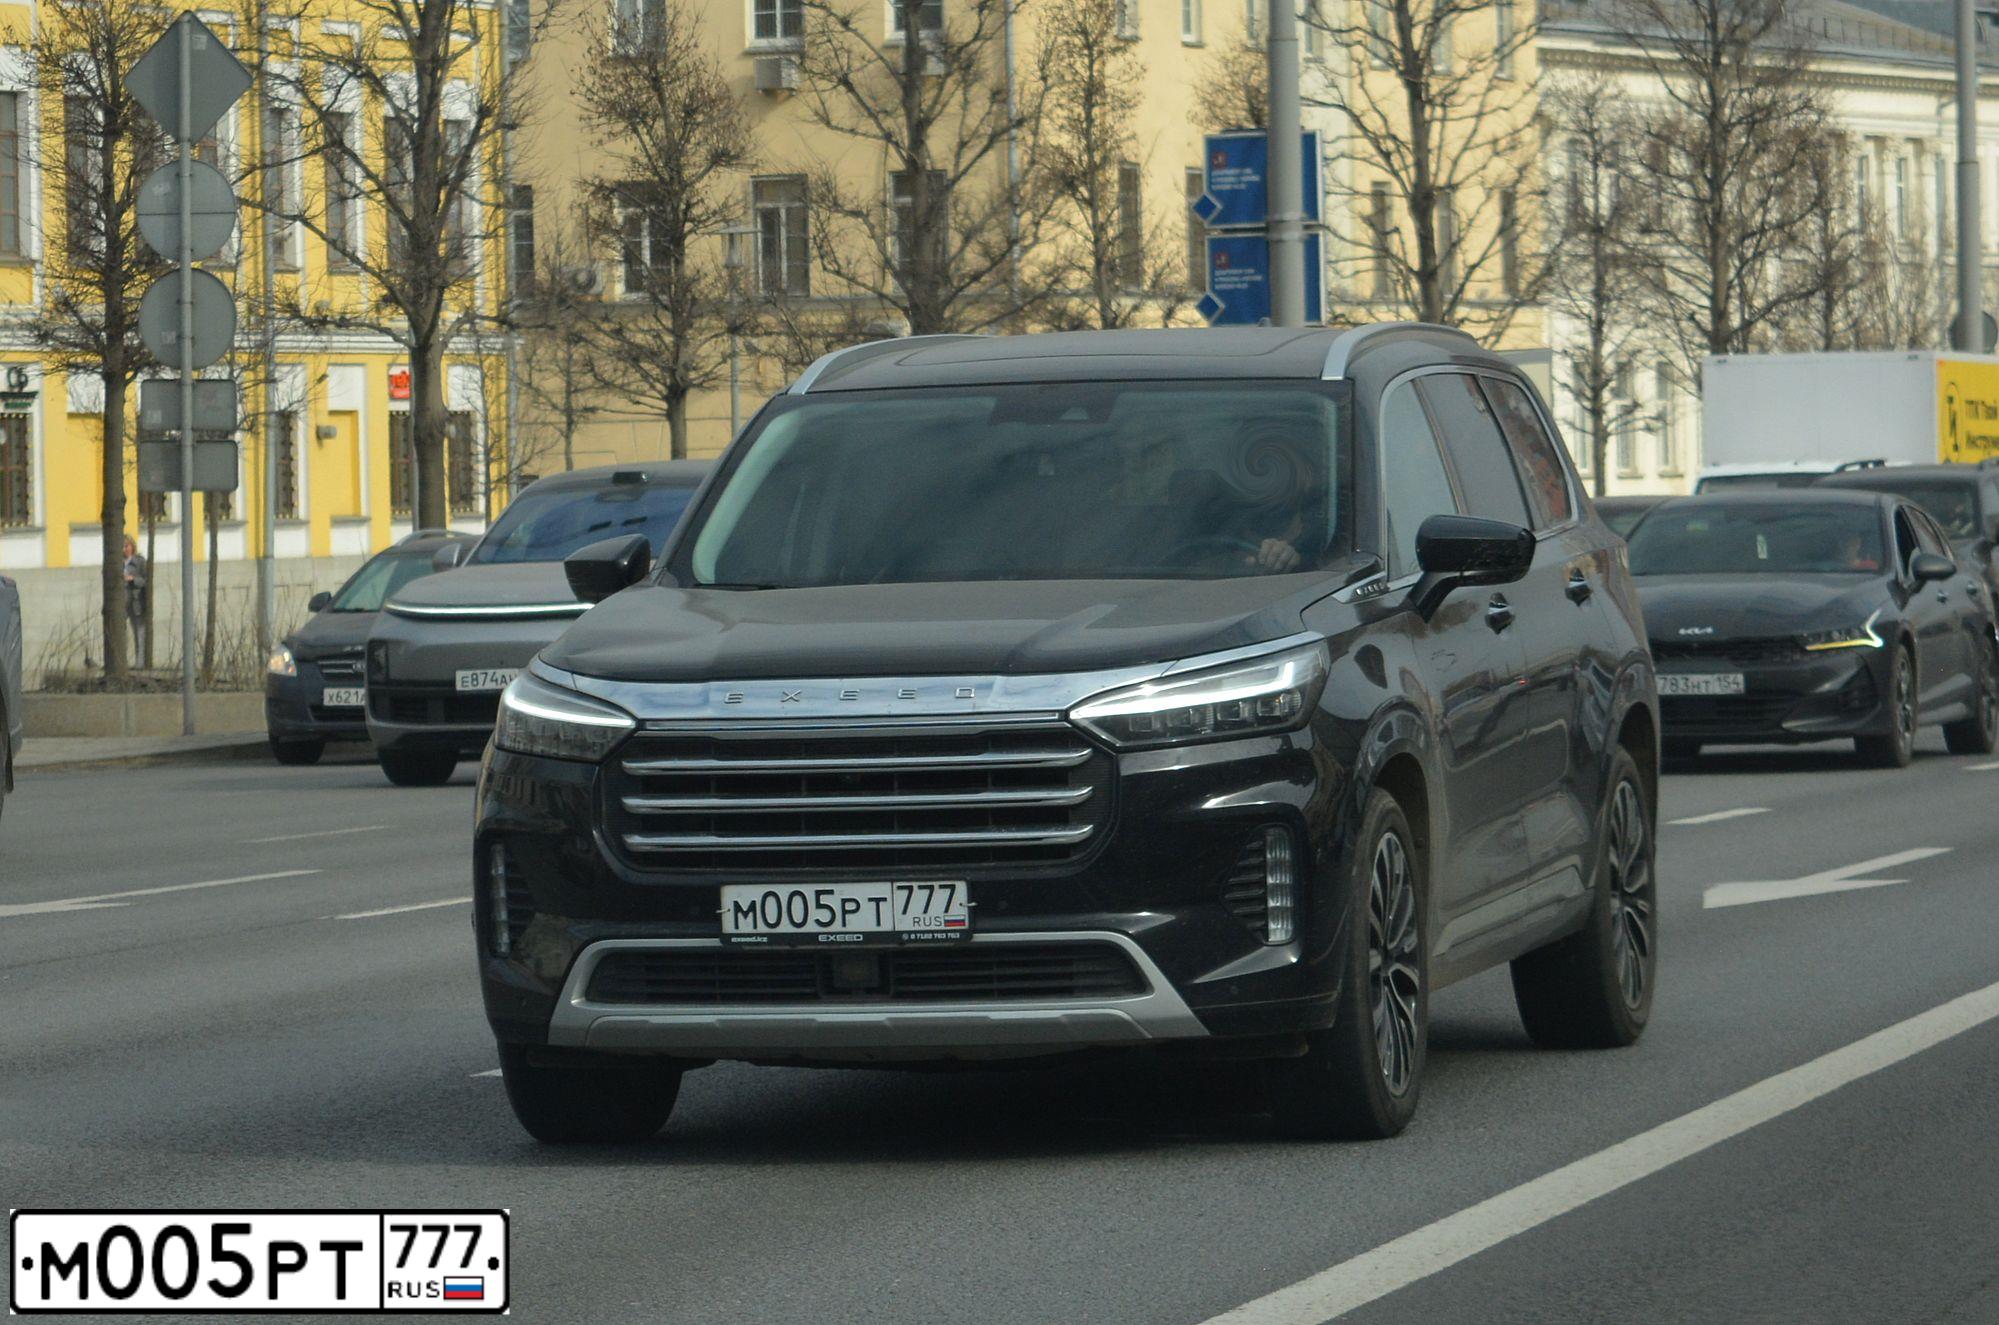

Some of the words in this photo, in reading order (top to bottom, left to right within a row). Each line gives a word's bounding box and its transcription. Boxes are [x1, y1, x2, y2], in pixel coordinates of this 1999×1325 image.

[1659, 677, 1711, 693] 783НТ
[724, 687, 976, 704] EXEED
[733, 889, 888, 929] М005РТ
[896, 884, 957, 915] 777
[912, 916, 943, 927] RUS
[818, 934, 863, 942] EXEED
